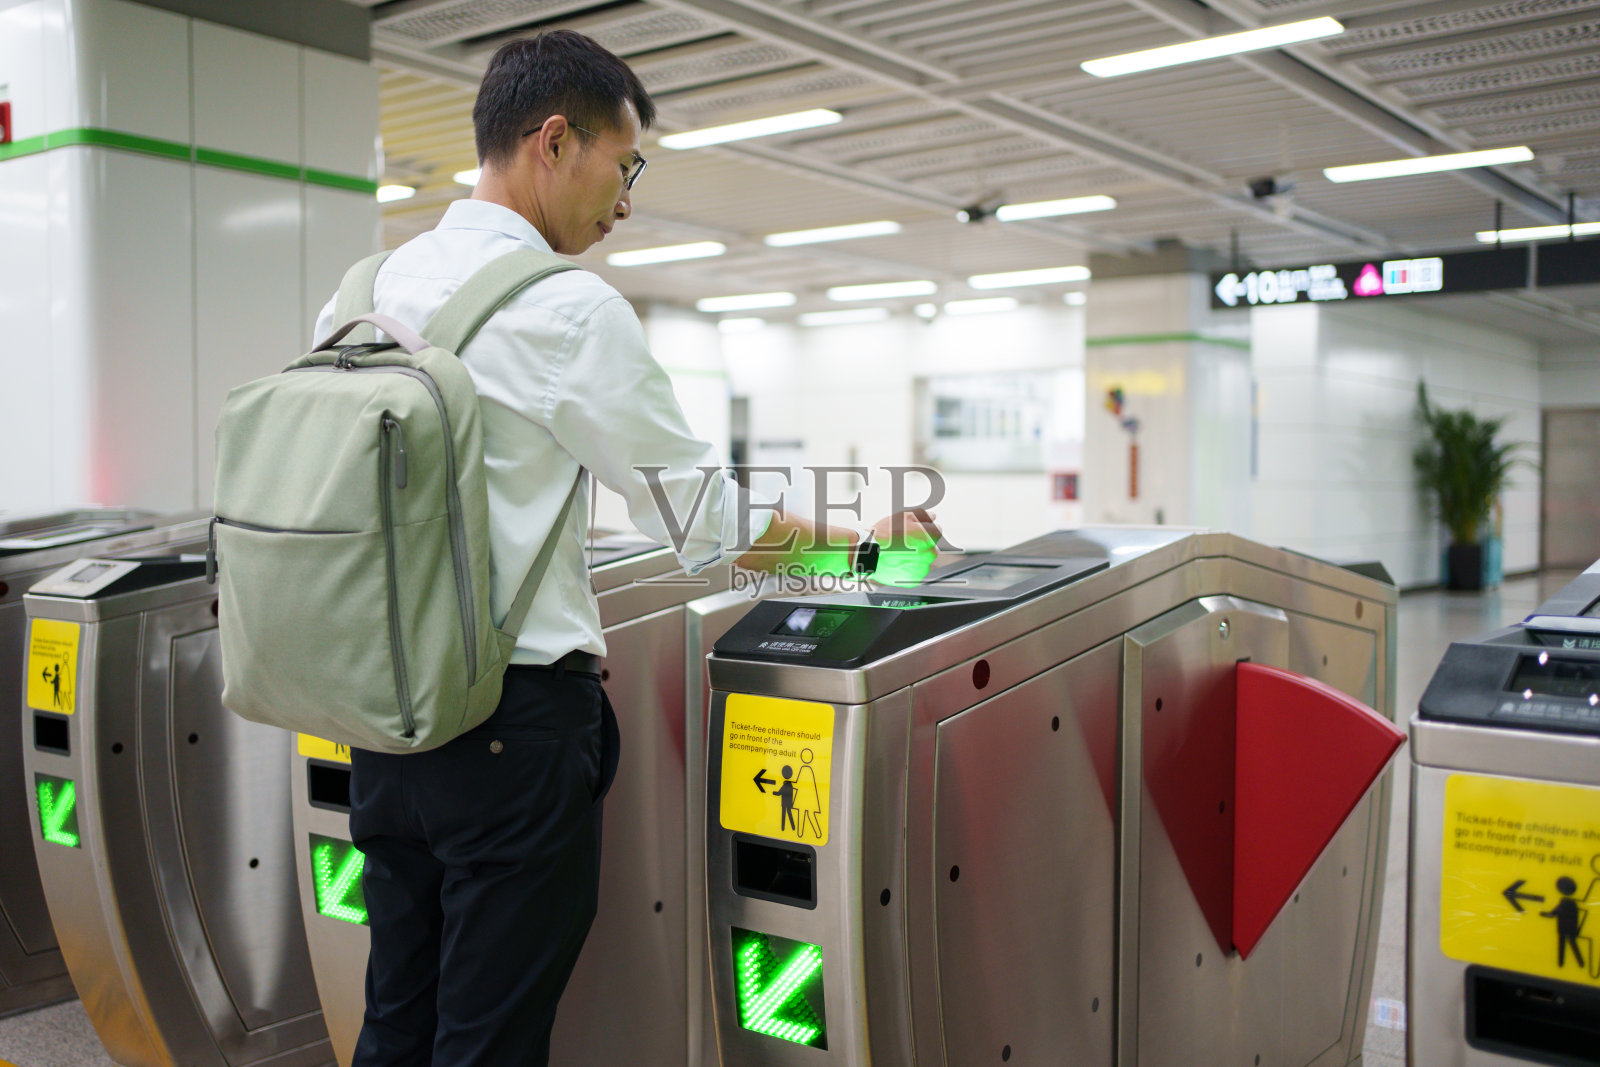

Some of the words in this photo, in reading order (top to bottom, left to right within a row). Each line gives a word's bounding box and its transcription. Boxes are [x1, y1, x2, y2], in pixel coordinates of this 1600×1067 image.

[729, 733, 739, 741] go
[746, 734, 763, 743] front
[763, 736, 771, 744] of
[771, 737, 783, 746] the
[731, 721, 766, 734] Ticket-free
[767, 727, 796, 738] children
[797, 731, 821, 741] should
[729, 742, 777, 756] accompanying
[778, 748, 797, 758] adult
[1456, 812, 1522, 830] Ticket-free
[1526, 822, 1579, 837] children
[1454, 827, 1470, 838] go
[1472, 827, 1484, 838] in
[1486, 829, 1516, 844] front
[1518, 834, 1533, 845] of
[1534, 836, 1555, 848] the
[1454, 841, 1545, 864] accompanying
[1549, 852, 1583, 866] adult
